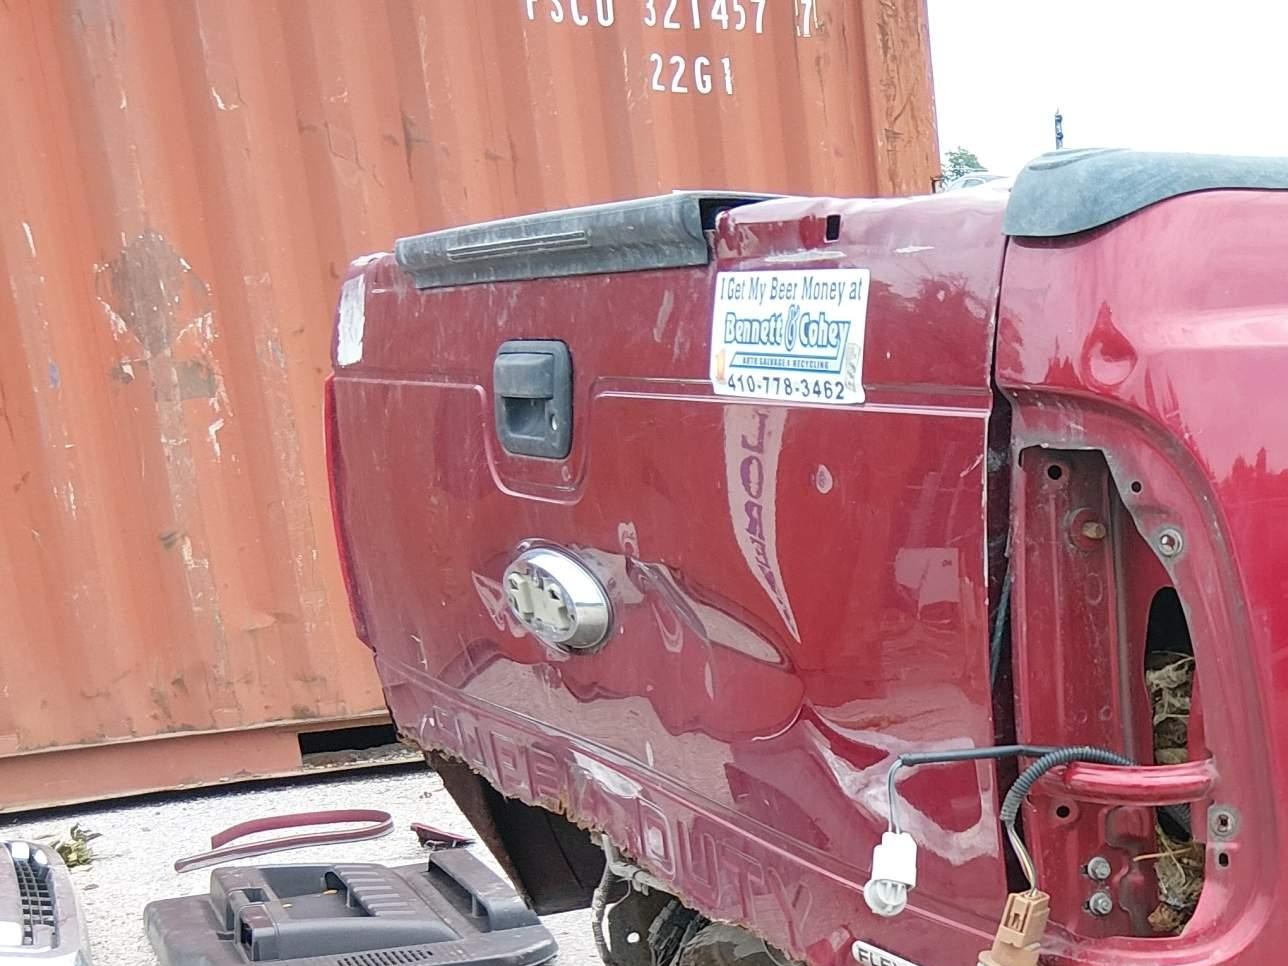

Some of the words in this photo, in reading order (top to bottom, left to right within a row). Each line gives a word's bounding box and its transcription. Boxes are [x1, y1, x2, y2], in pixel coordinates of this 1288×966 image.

[649, 52, 734, 95] 22G1
[720, 277, 726, 300] I
[727, 276, 747, 300] Get
[748, 276, 767, 305] My
[769, 276, 799, 301] Beer
[800, 276, 846, 306] Money
[848, 277, 863, 301] at
[723, 311, 784, 346] Bennett
[799, 311, 852, 349] Cohey
[792, 359, 830, 370] RECYCLING
[727, 373, 845, 400] 410-778-3462
